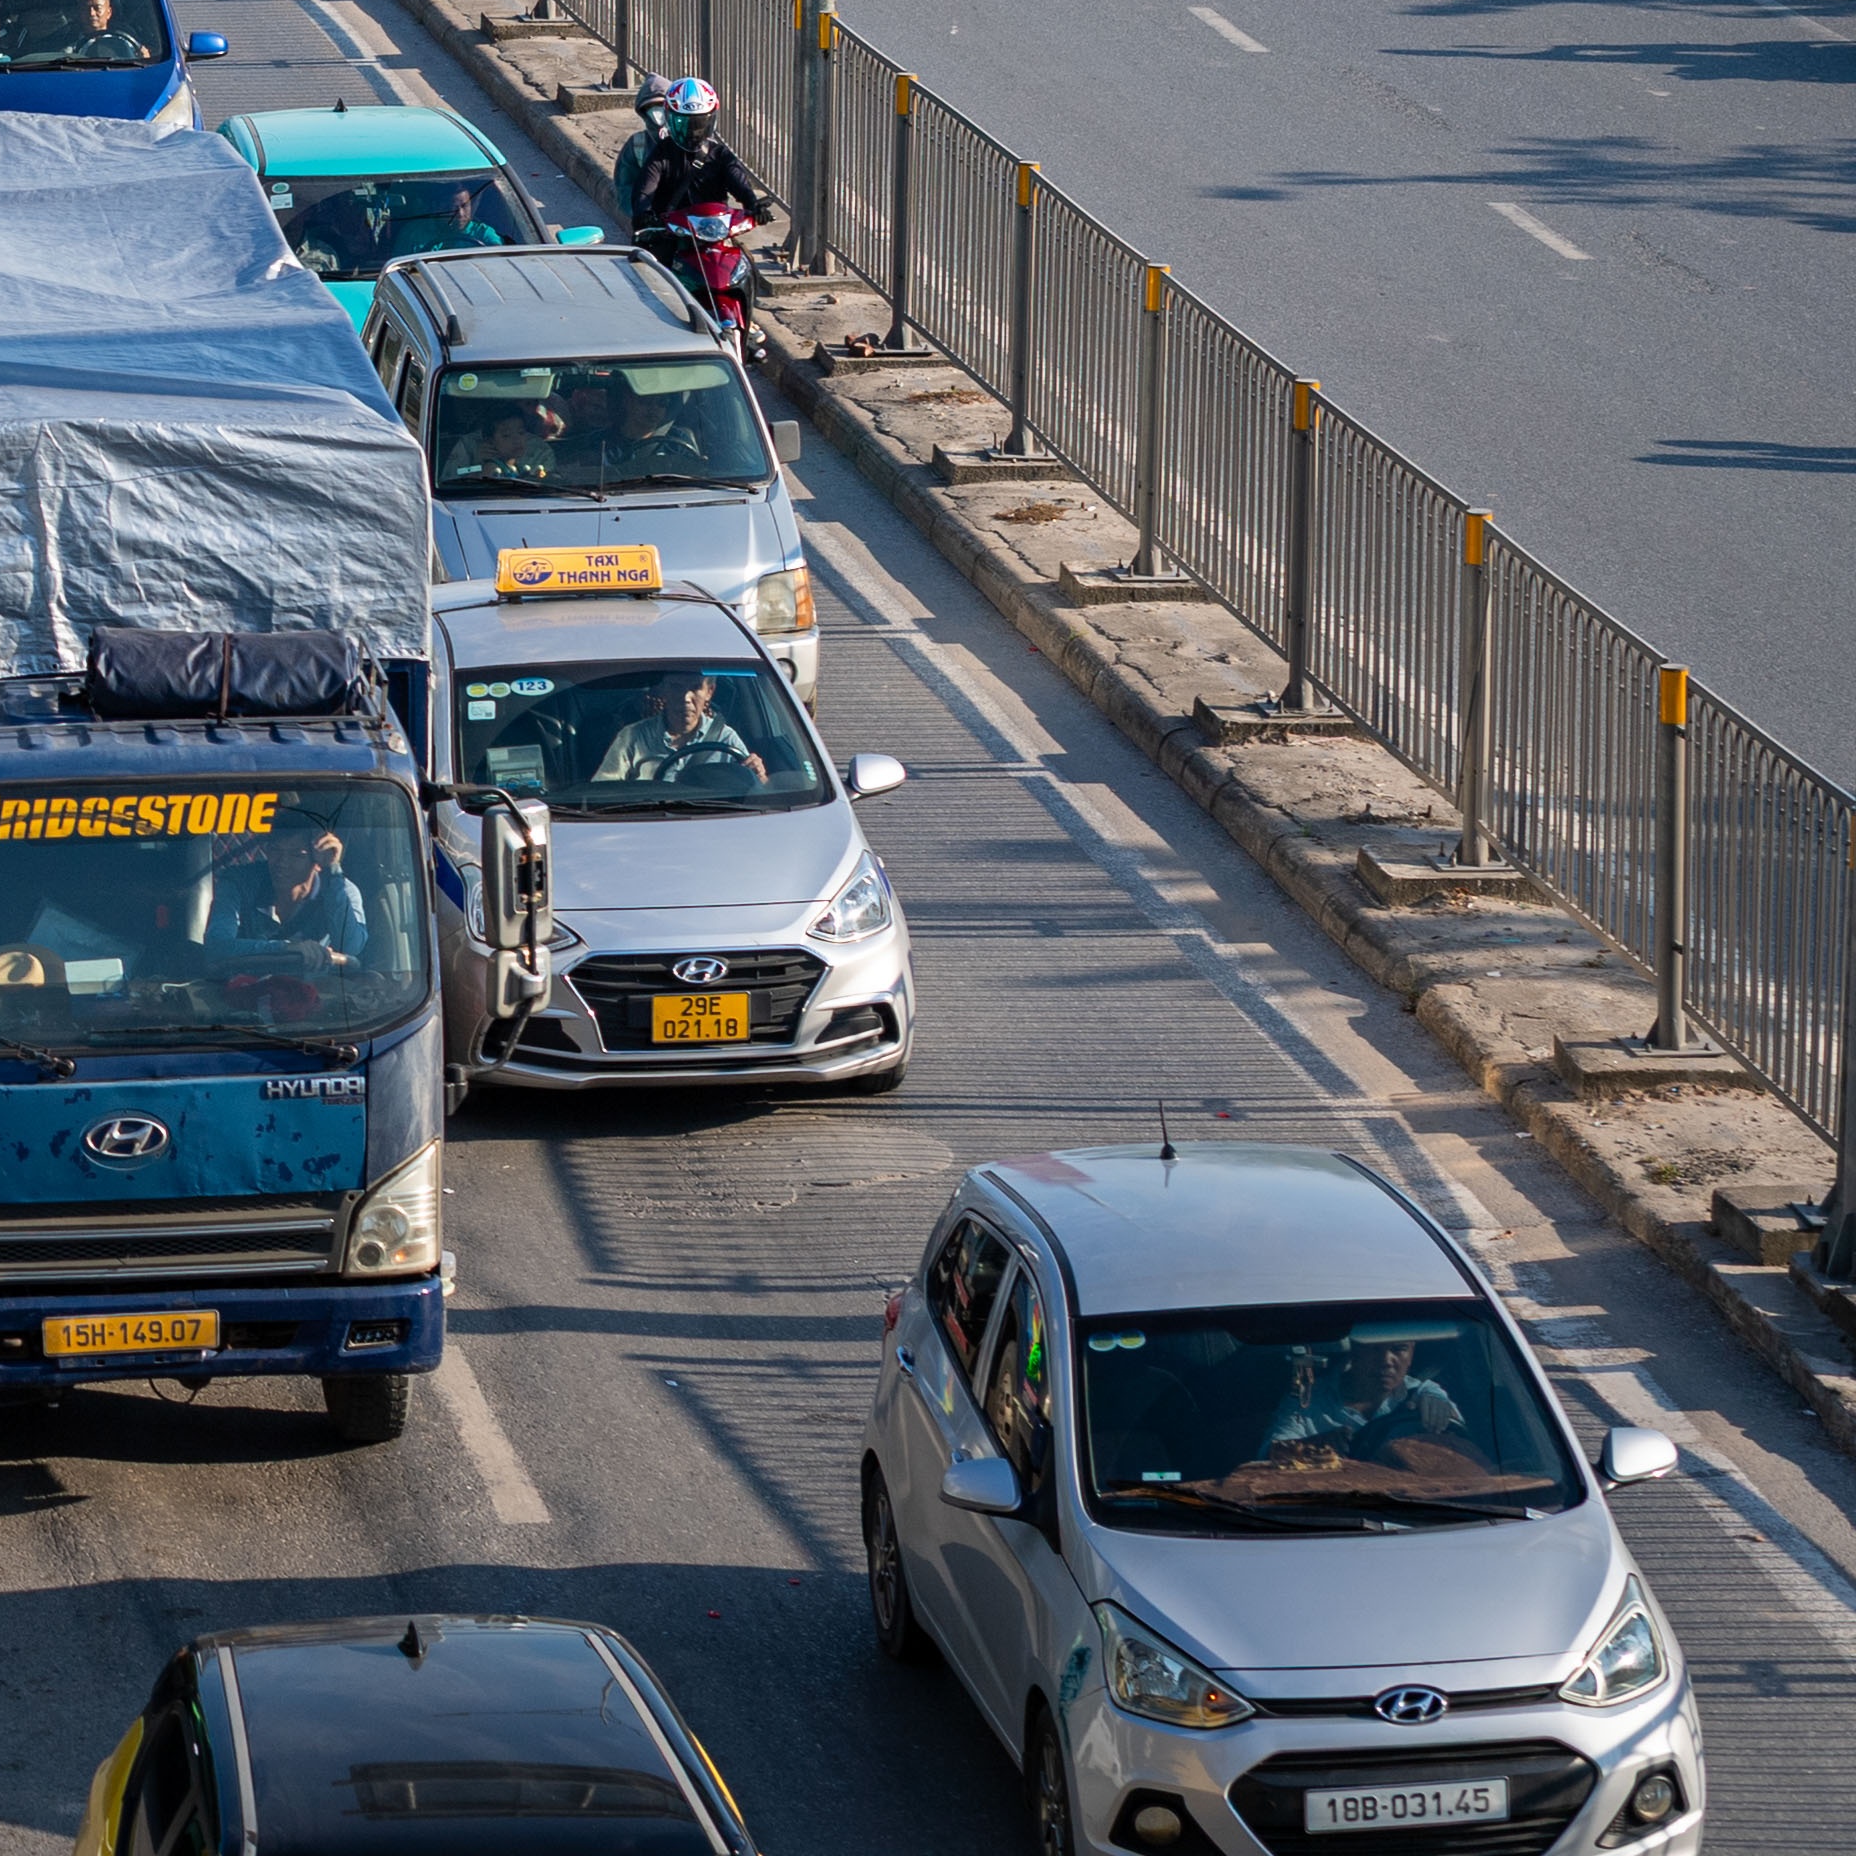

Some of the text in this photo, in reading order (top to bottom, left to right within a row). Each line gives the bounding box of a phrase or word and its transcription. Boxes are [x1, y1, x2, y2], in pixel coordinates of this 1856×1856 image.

[585, 554, 621, 567] TAXI
[557, 570, 612, 585] THANH
[617, 568, 650, 583] NGA
[518, 680, 548, 692] 123
[680, 996, 722, 1017] 29E
[663, 1018, 739, 1041] 021.18
[61, 1318, 203, 1349] 15H-149.07
[1326, 1787, 1492, 1825] 18B-031.45
